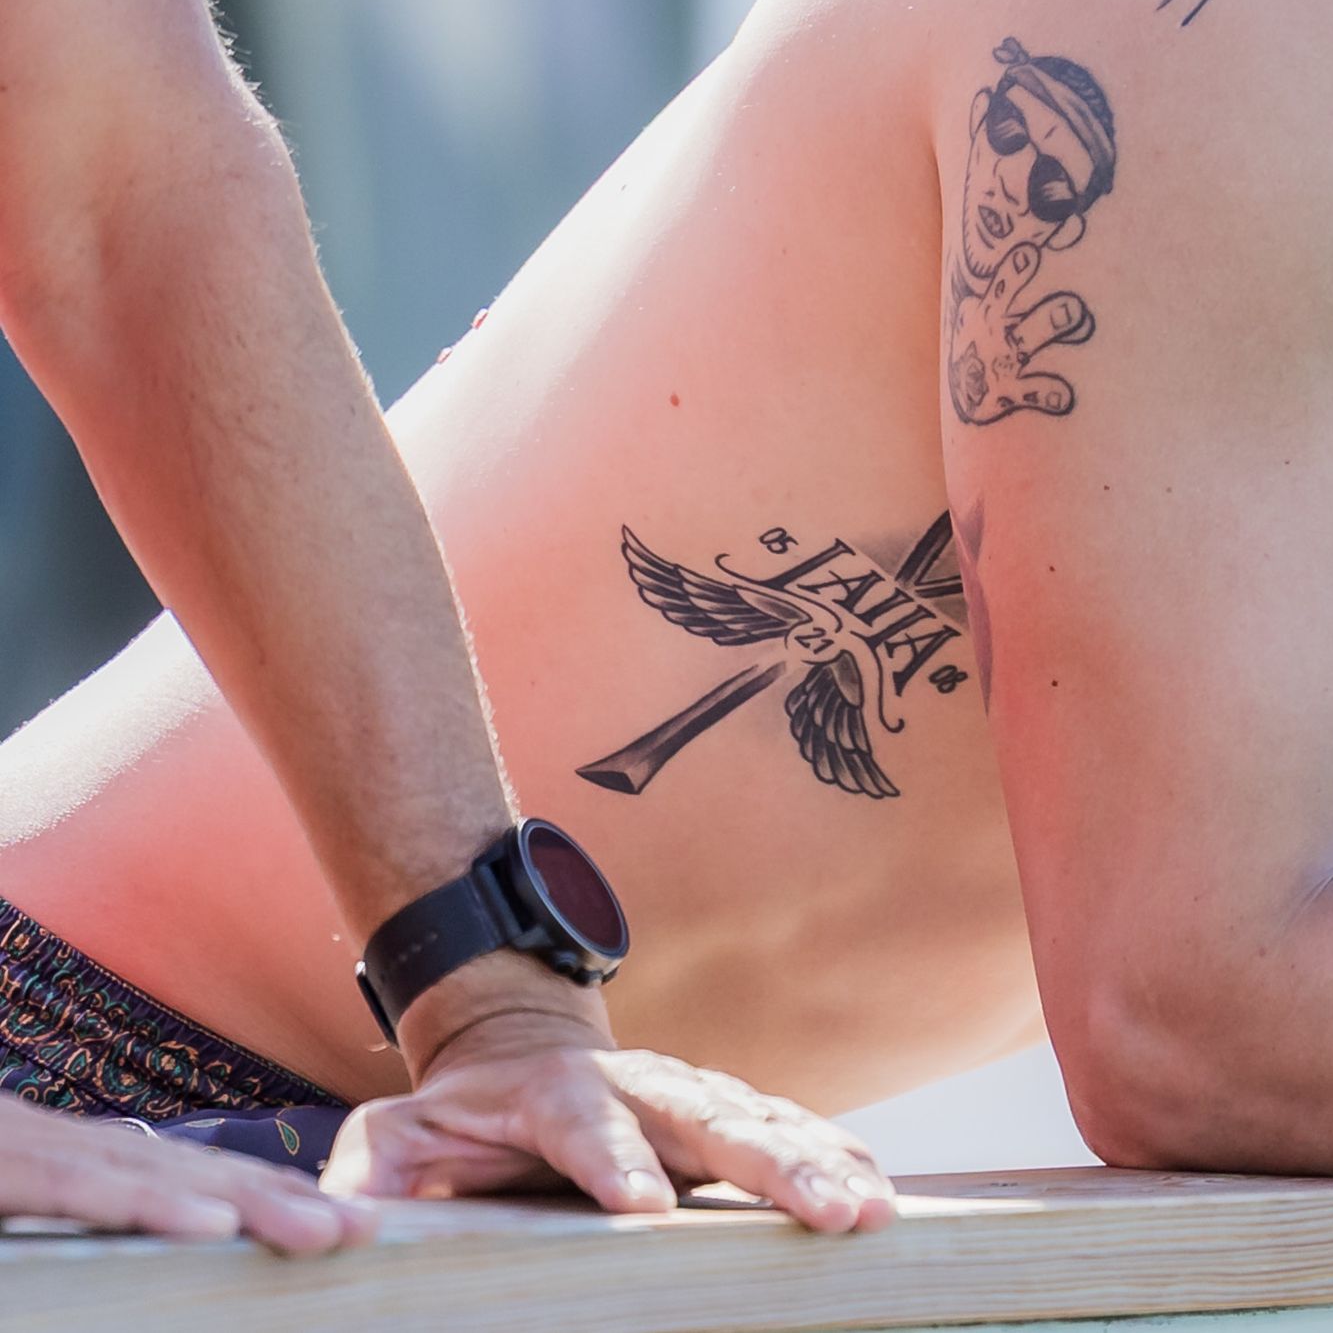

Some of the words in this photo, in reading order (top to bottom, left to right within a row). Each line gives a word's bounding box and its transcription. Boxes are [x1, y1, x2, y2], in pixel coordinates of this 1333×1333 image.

[759, 526, 798, 555] 05
[794, 627, 834, 655] 21
[928, 664, 969, 694] 08
